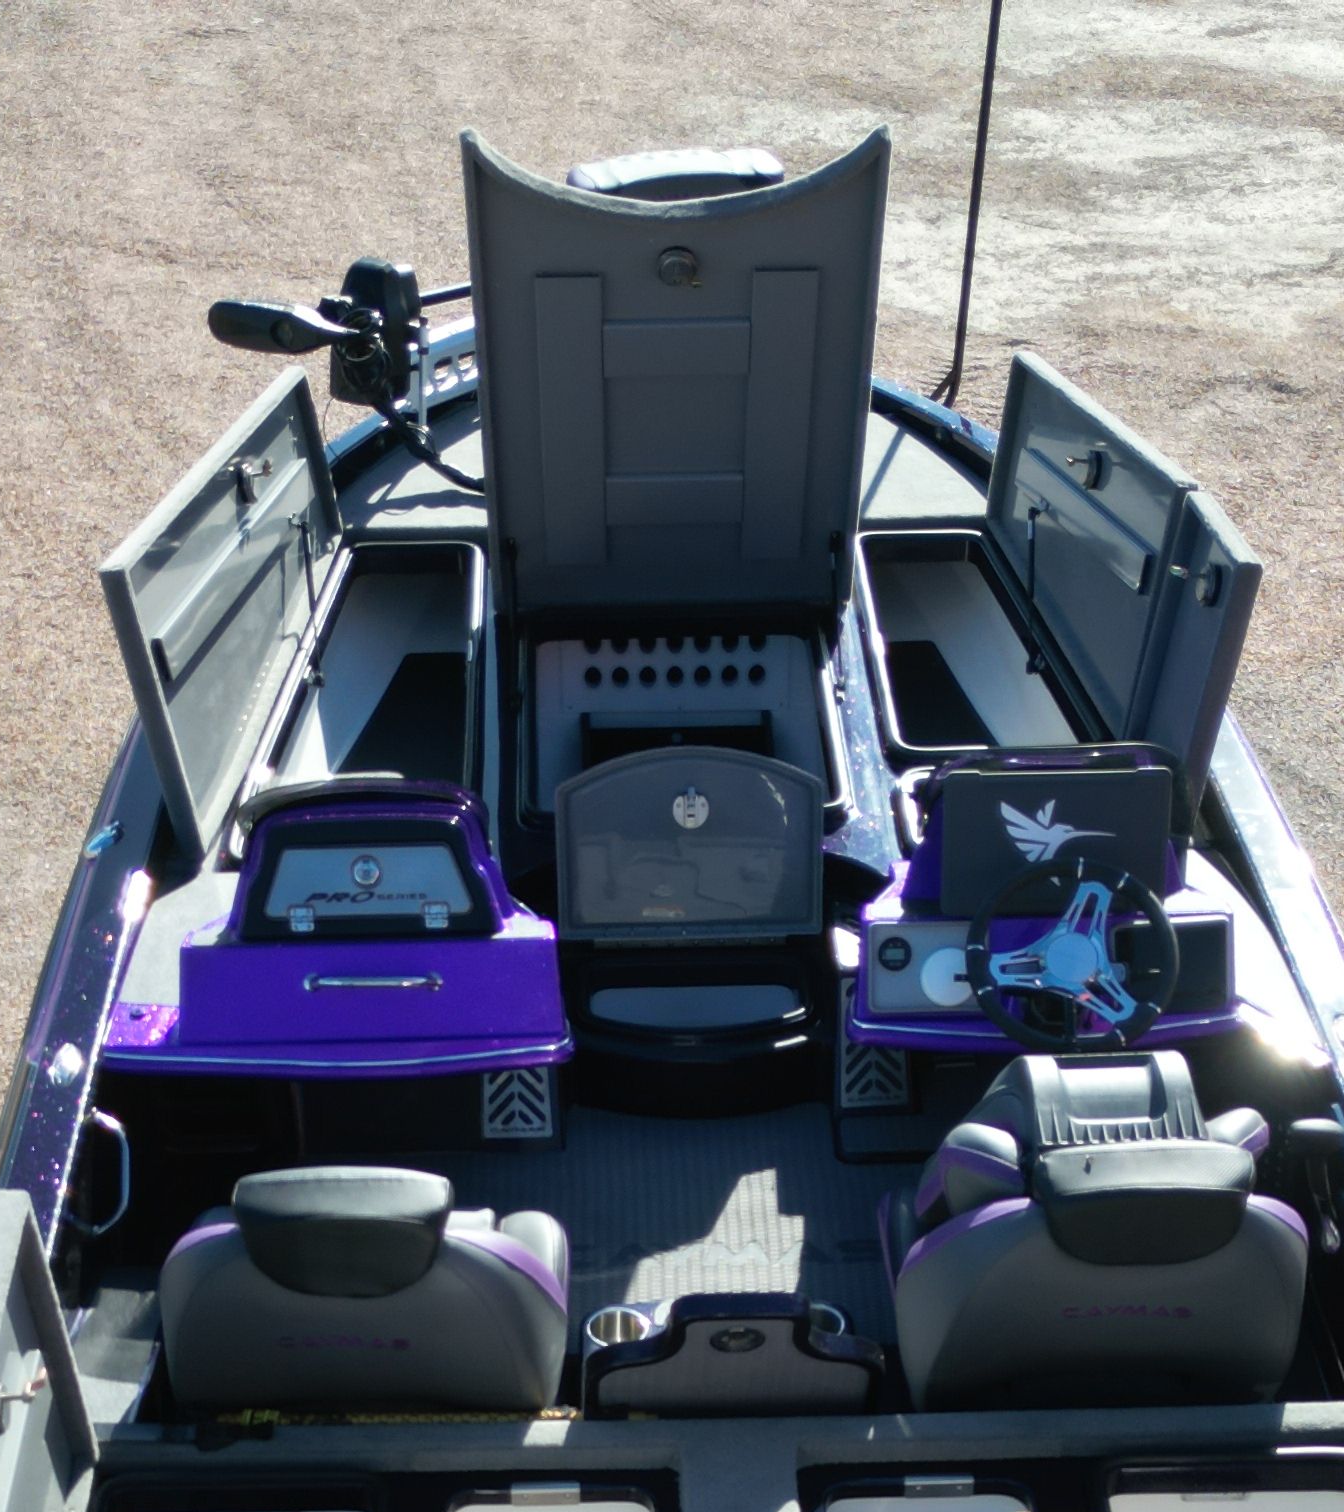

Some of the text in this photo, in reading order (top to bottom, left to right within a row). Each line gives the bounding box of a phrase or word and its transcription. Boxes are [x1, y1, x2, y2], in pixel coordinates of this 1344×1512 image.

[305, 891, 428, 903] PRO SERIES
[1060, 1304, 1194, 1319] CAYMAS
